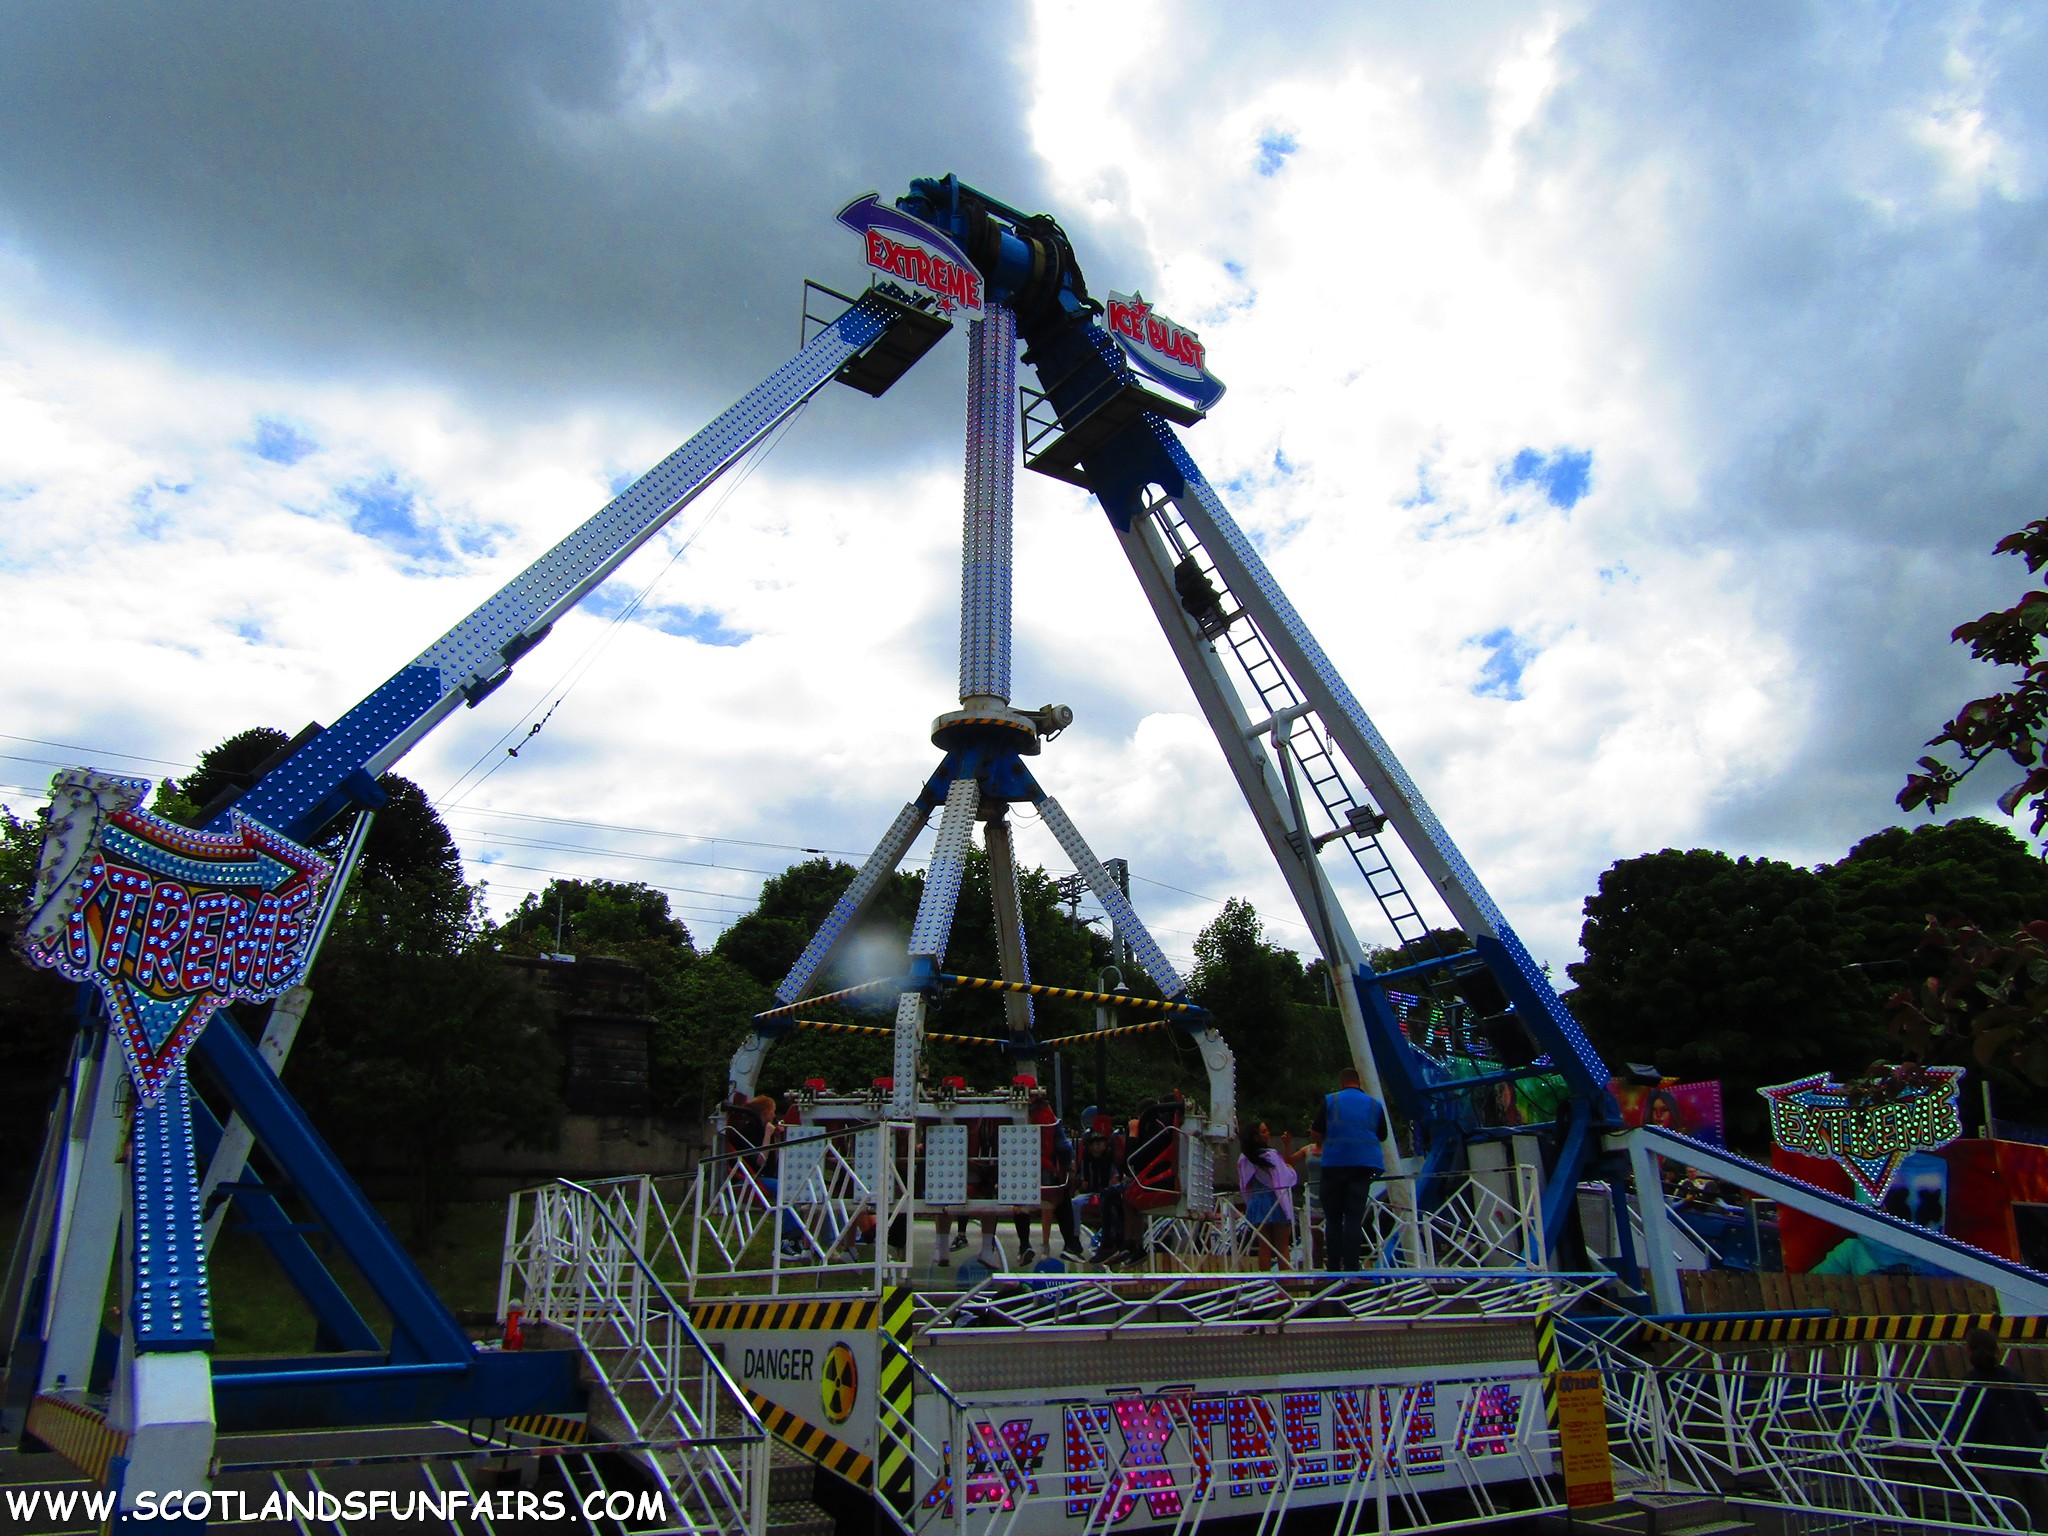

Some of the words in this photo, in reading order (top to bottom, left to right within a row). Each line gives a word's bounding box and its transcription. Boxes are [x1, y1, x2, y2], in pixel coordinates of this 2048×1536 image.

[866, 229, 983, 310] EXTREME
[1108, 300, 1144, 344] ICE
[1147, 318, 1206, 370] BLAST
[1776, 1082, 1960, 1154] EXTREME
[743, 1348, 814, 1381] DANGER
[1063, 1382, 1446, 1528] EXTREME
